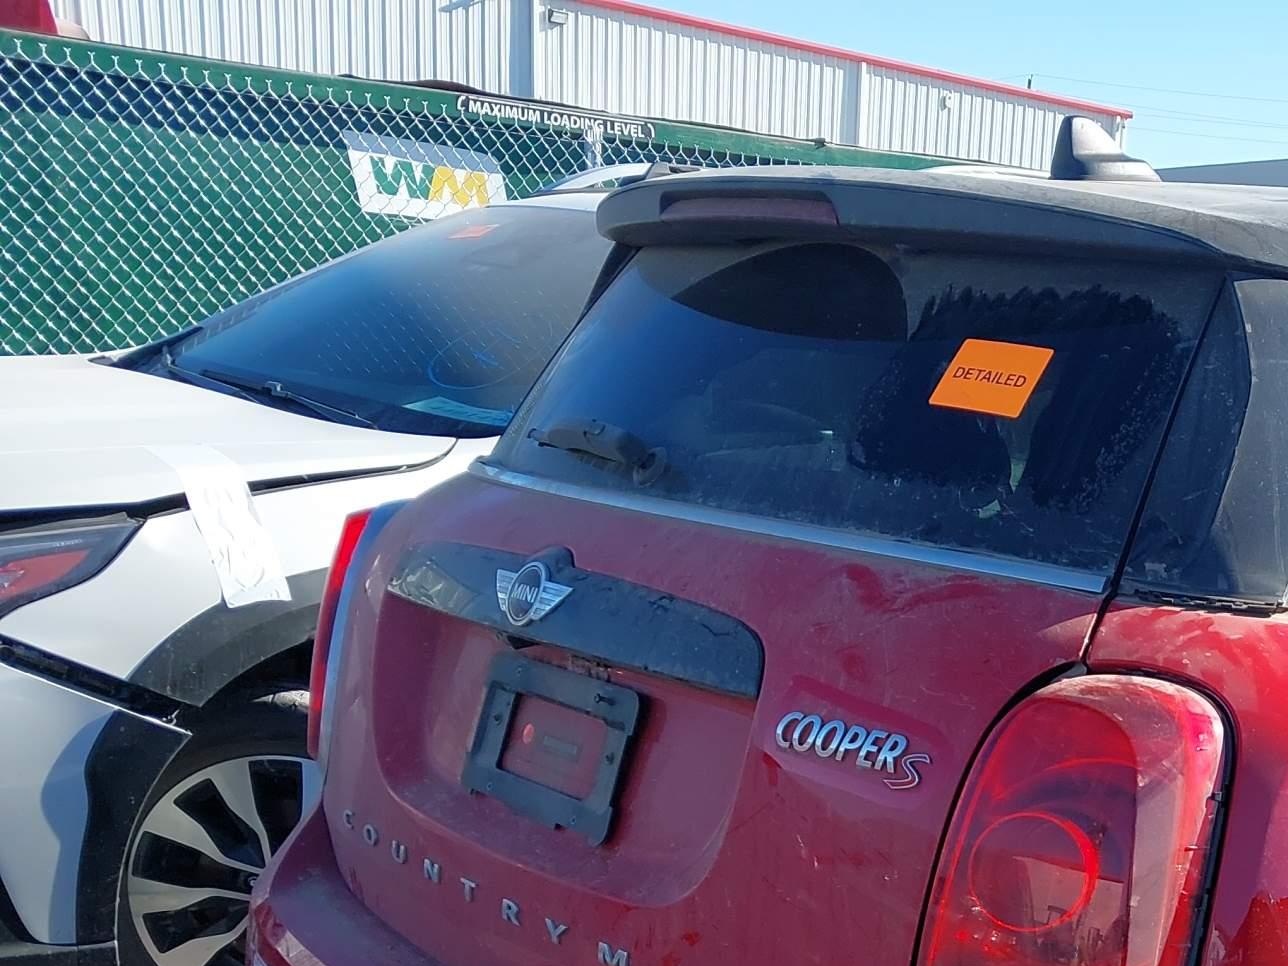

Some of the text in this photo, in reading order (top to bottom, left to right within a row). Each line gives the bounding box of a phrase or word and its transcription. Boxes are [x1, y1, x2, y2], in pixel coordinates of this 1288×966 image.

[467, 99, 646, 139] MAXIMUM LOADING LEVEL
[368, 154, 491, 208] WM
[952, 366, 1028, 388] DETAILED
[512, 584, 539, 604] MINI
[775, 711, 931, 790] COOPER S
